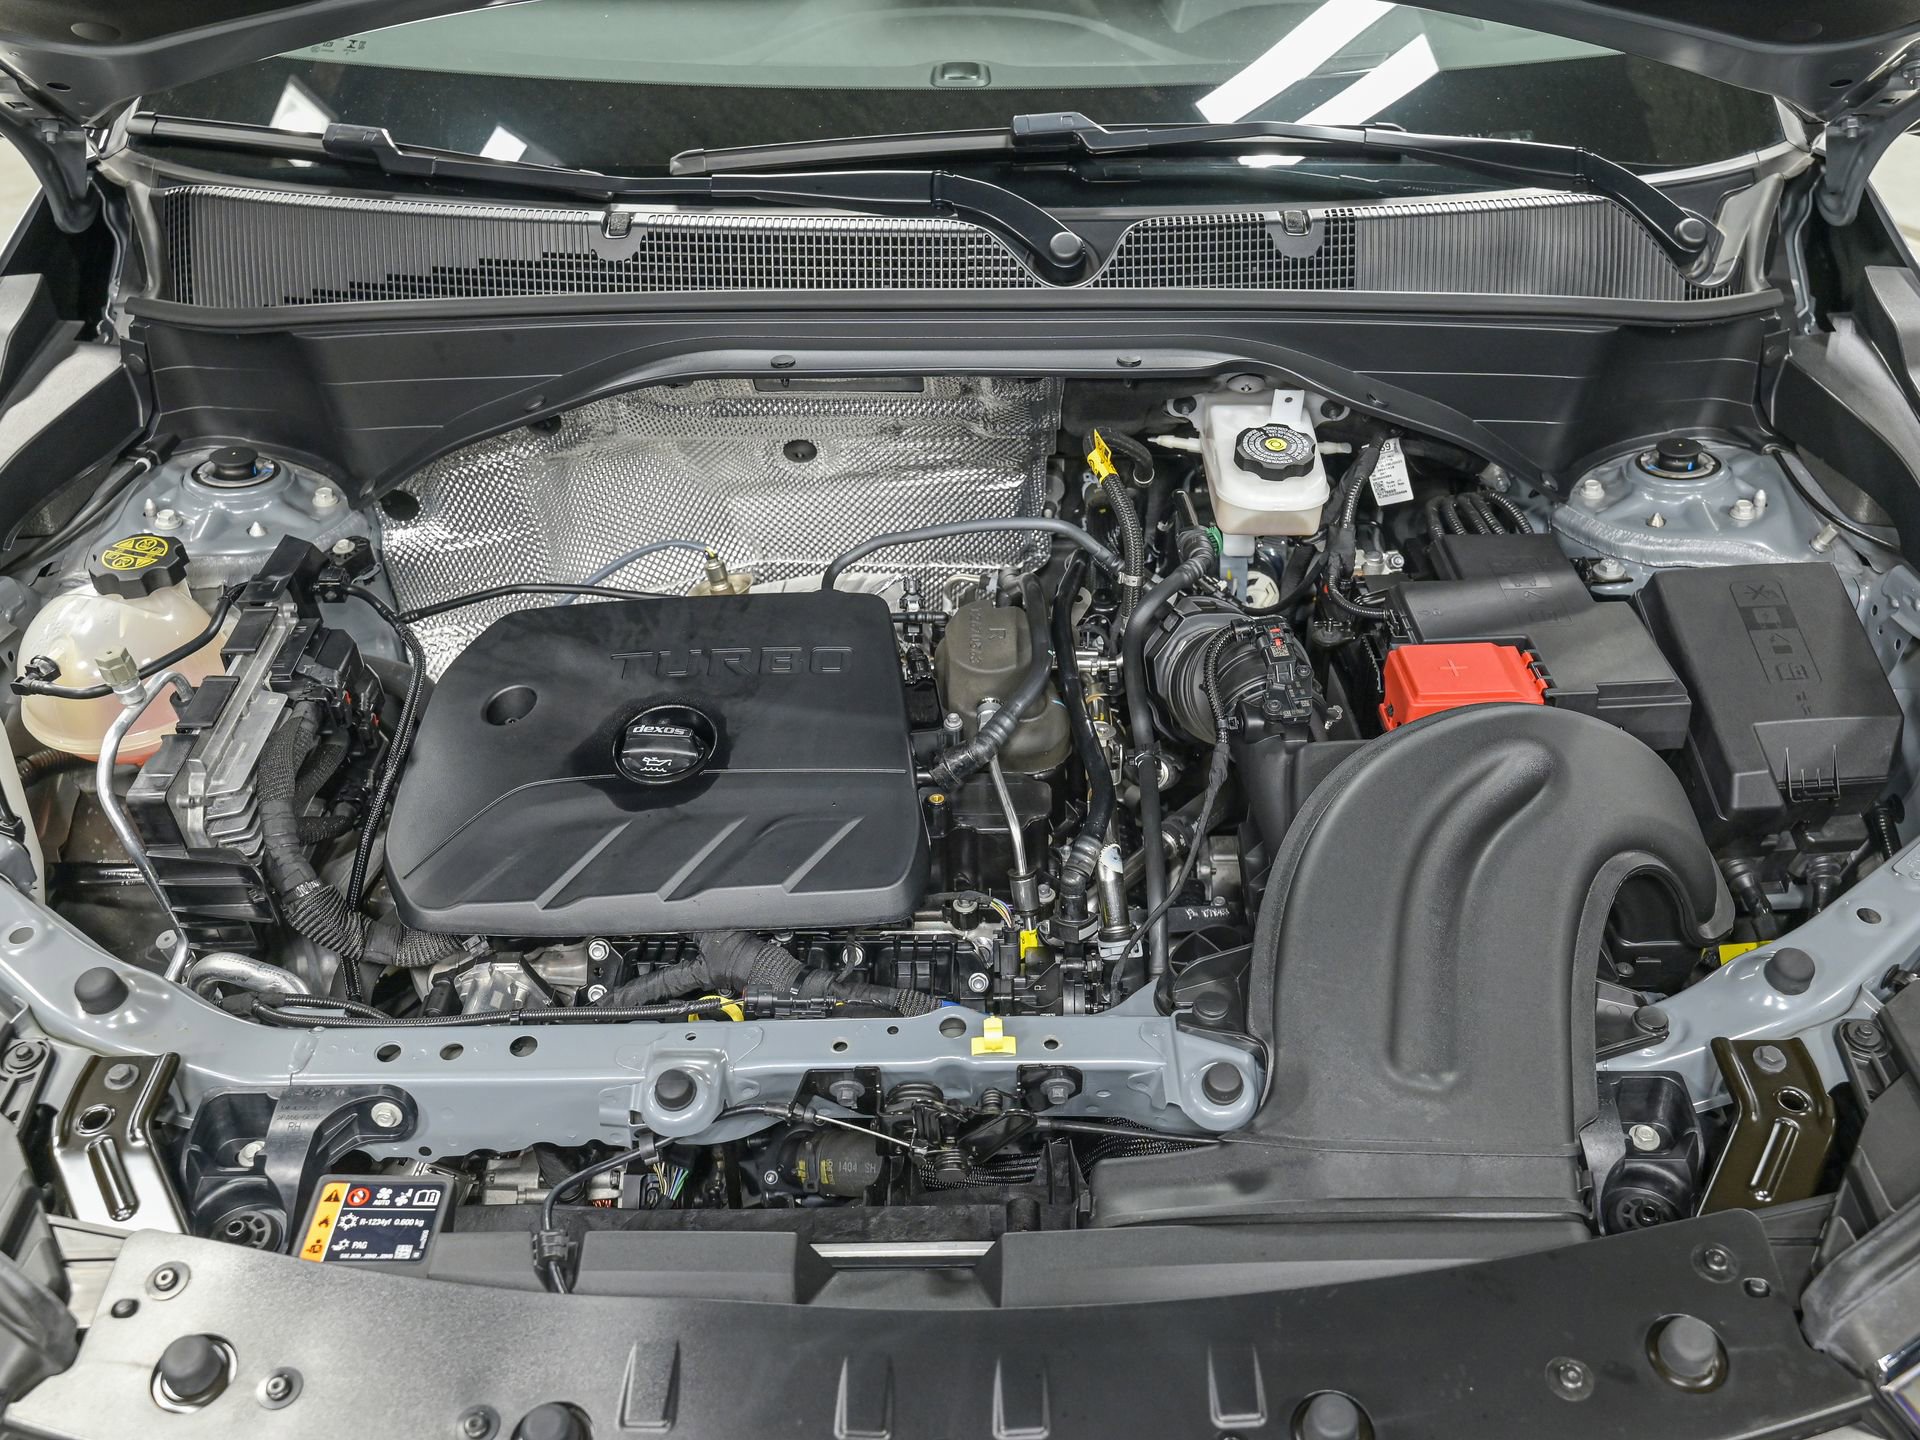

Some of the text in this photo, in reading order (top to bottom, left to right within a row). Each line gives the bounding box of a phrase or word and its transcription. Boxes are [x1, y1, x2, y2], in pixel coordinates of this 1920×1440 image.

[610, 646, 853, 679] TURBO
[632, 724, 687, 735] dexos
[287, 1121, 302, 1131] RH
[359, 1218, 392, 1227] R-1234yf
[414, 1218, 425, 1227] kg
[351, 1241, 368, 1250] PAG
